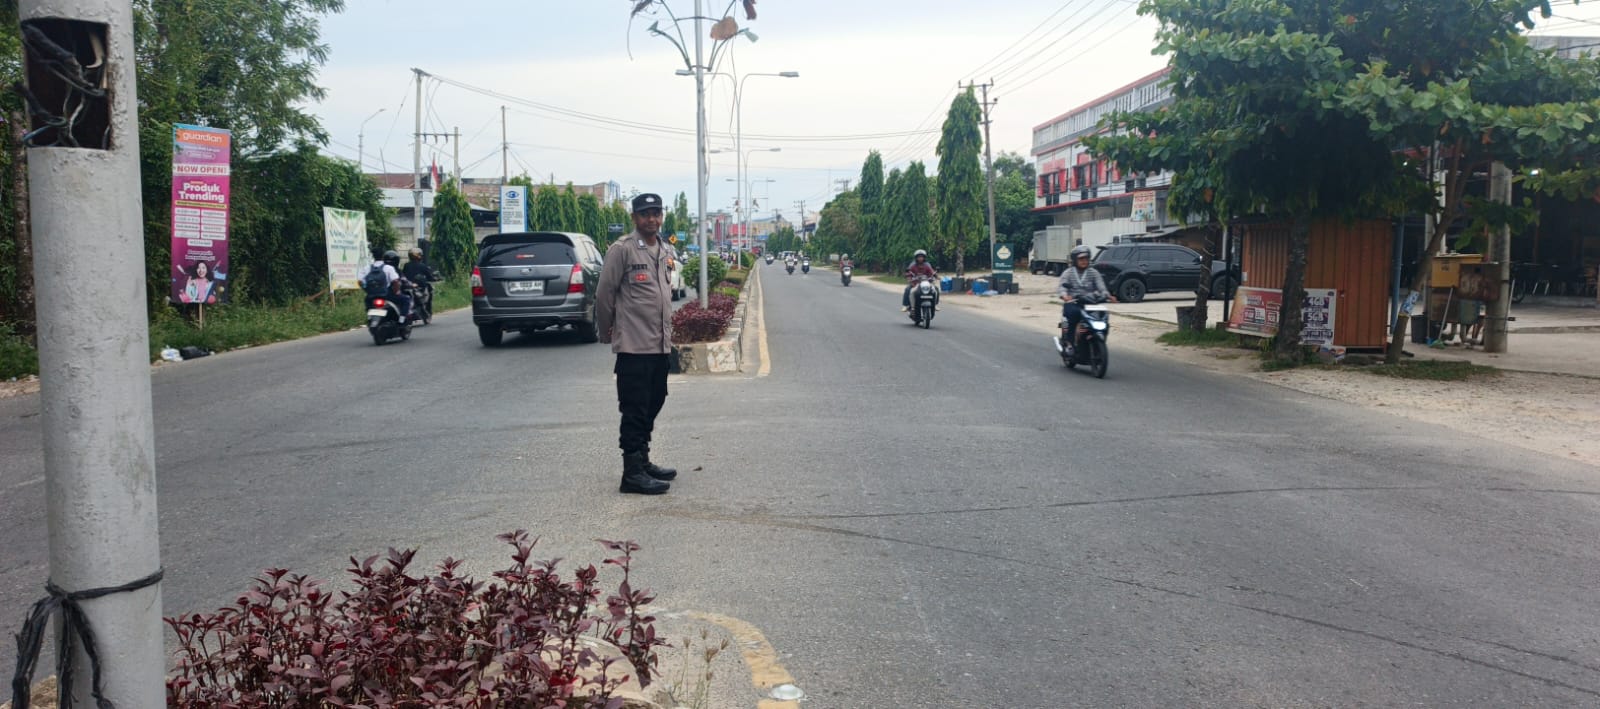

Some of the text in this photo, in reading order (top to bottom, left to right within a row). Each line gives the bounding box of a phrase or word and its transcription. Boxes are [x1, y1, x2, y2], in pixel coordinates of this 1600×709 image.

[183, 132, 222, 142] guardian
[183, 182, 220, 192] Produk
[178, 191, 225, 203] Trending
[1307, 312, 1324, 321] 5GB
